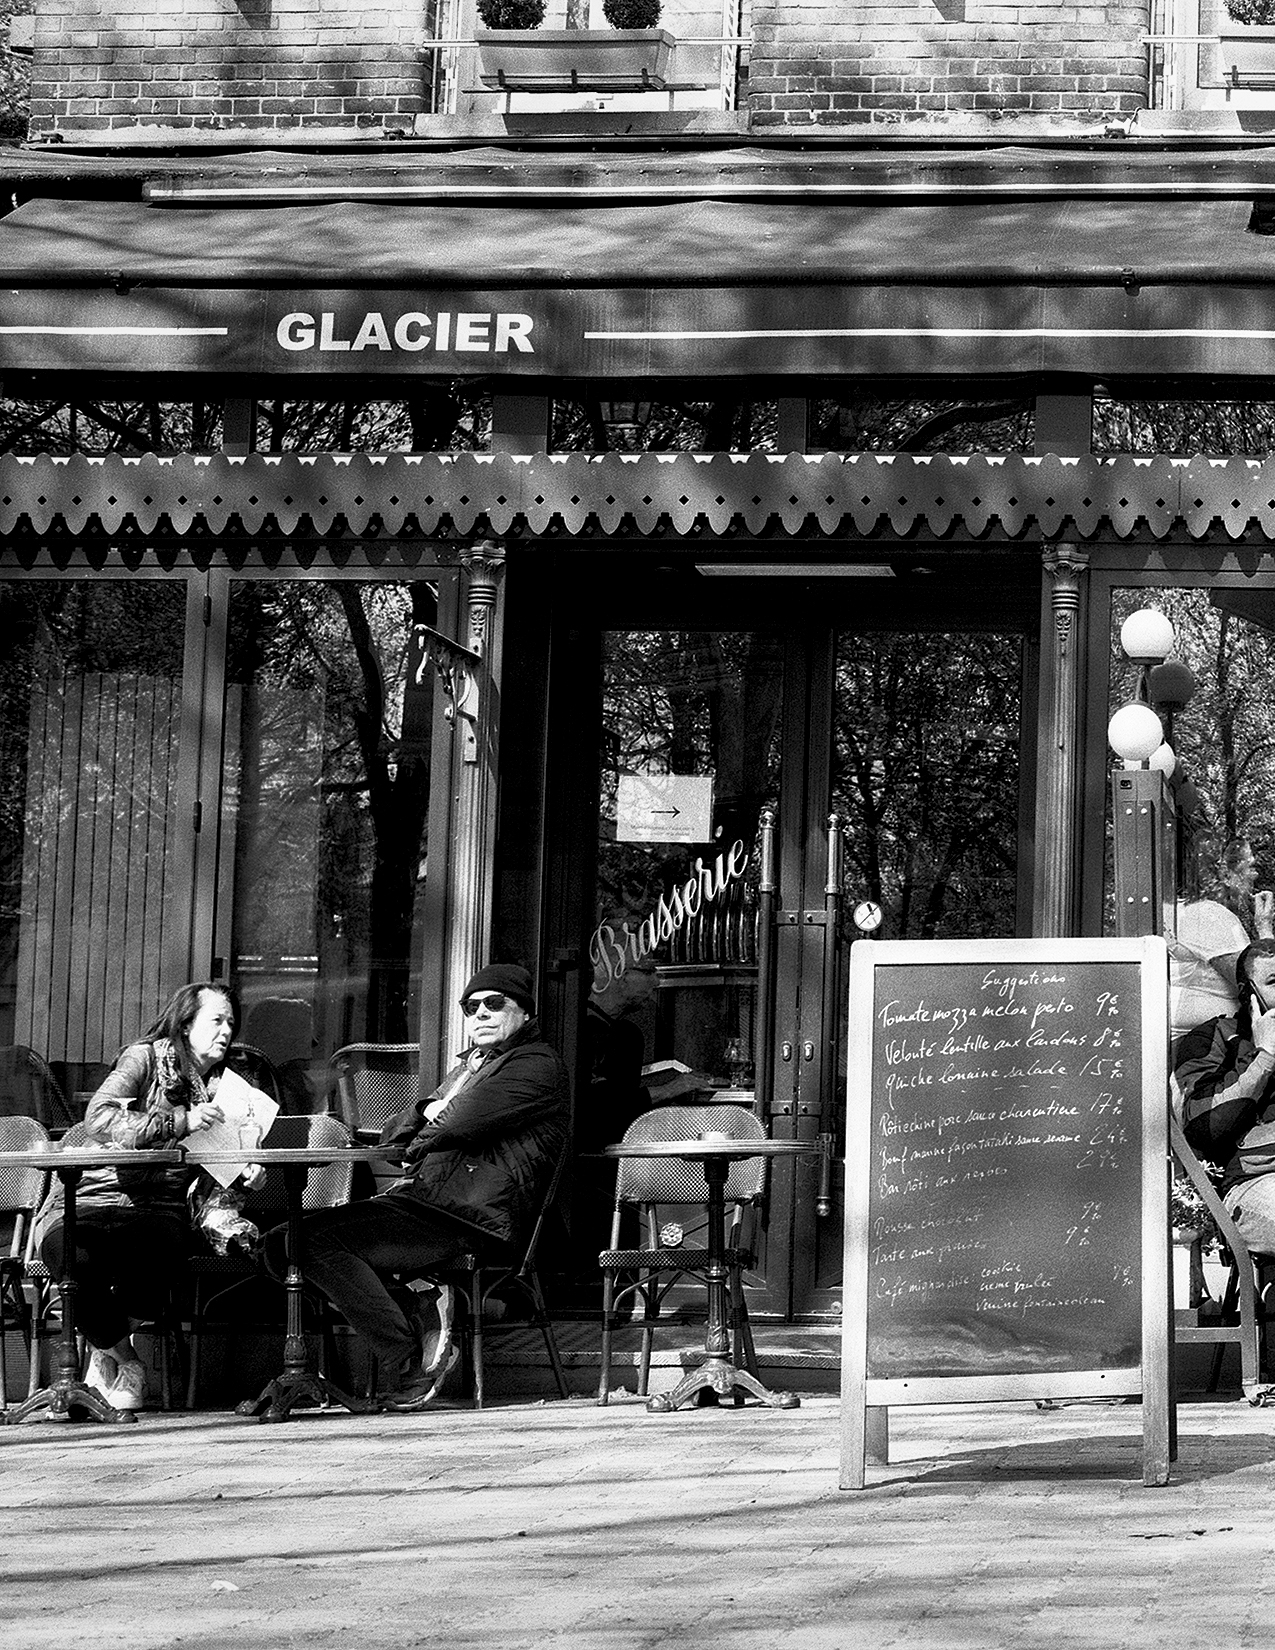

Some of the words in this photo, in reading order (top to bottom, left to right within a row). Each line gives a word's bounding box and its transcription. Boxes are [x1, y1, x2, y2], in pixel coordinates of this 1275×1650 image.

[276, 312, 535, 353] GLACIER
[589, 825, 749, 994] Brasserie
[981, 969, 1066, 1000] Suggestions
[878, 1000, 930, 1028] Tomate
[932, 1007, 977, 1034] mozza
[982, 999, 1028, 1017] melon
[1030, 997, 1074, 1029] pesto
[885, 1038, 938, 1066] Velouté
[939, 1034, 990, 1056] lentille
[993, 1038, 1021, 1051] aux
[1026, 1028, 1087, 1048] lardons
[1003, 1059, 1068, 1079] salade
[872, 1243, 906, 1265] Tarte
[876, 1275, 907, 1308] Café
